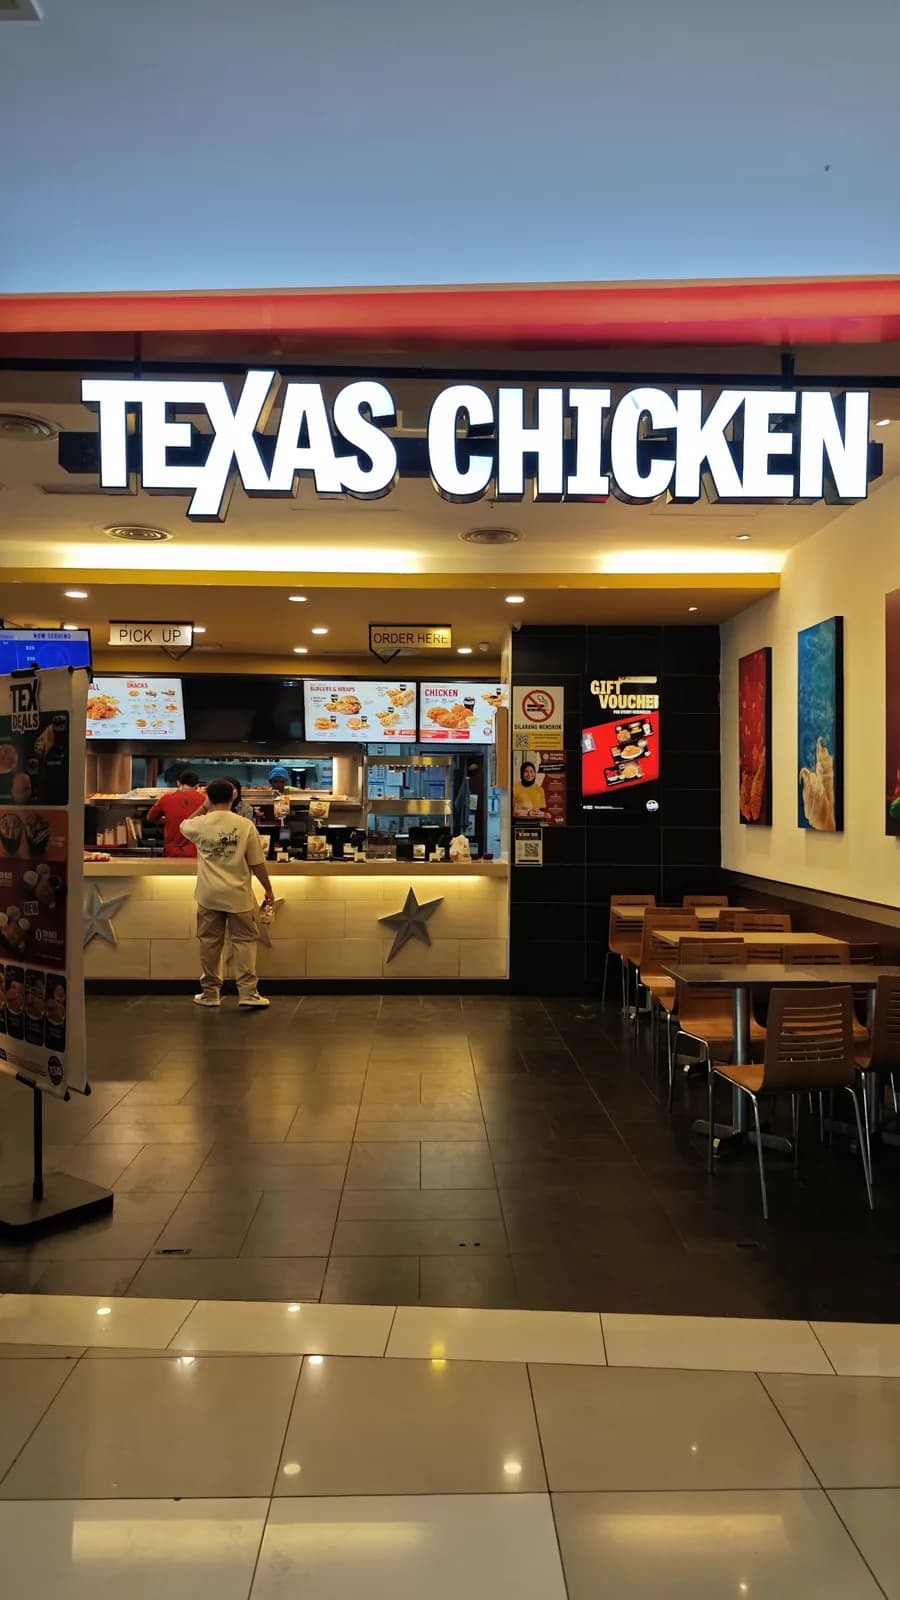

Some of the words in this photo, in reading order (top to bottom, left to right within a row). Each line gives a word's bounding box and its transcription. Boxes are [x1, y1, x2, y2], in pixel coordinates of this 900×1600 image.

[81, 369, 397, 518] TEXAS
[427, 384, 868, 501] CHICKEN
[47, 632, 71, 640] SERVING
[119, 629, 153, 643] PICK
[162, 629, 182, 643] UP
[373, 632, 415, 644] ORDER
[417, 633, 449, 644] HERE
[424, 689, 458, 697] CHICKEN
[590, 680, 620, 695] GIFT
[9, 679, 38, 713] TEX
[12, 713, 39, 731] DEALS
